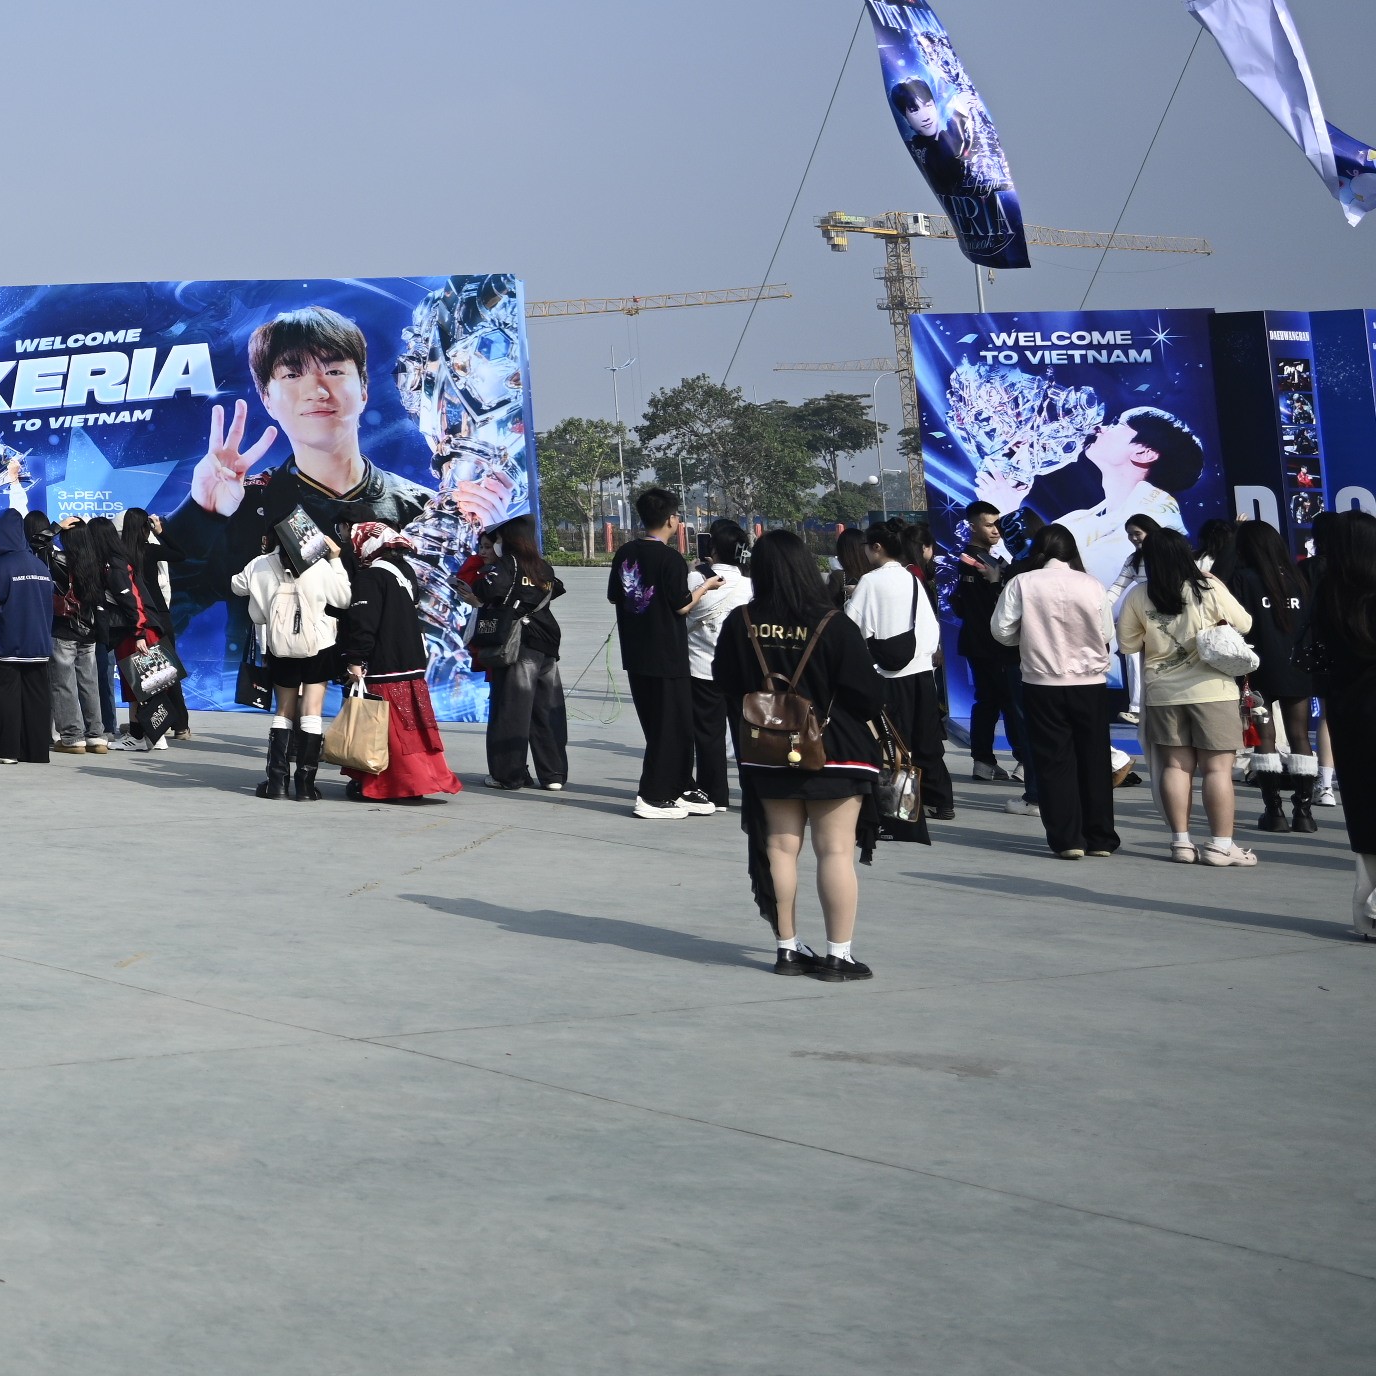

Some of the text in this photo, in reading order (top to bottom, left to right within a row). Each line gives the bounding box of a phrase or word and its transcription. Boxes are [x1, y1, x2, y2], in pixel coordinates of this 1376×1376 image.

[15, 328, 142, 353] WELCOME
[990, 330, 1132, 346] WELCOME
[980, 349, 1152, 365] TO VIETNAM
[13, 409, 153, 432] TO VIETNAM
[57, 490, 112, 500] 3-PEAT
[58, 501, 124, 511] WORLDS
[1261, 596, 1300, 609] OER
[748, 623, 808, 641] DORAN
